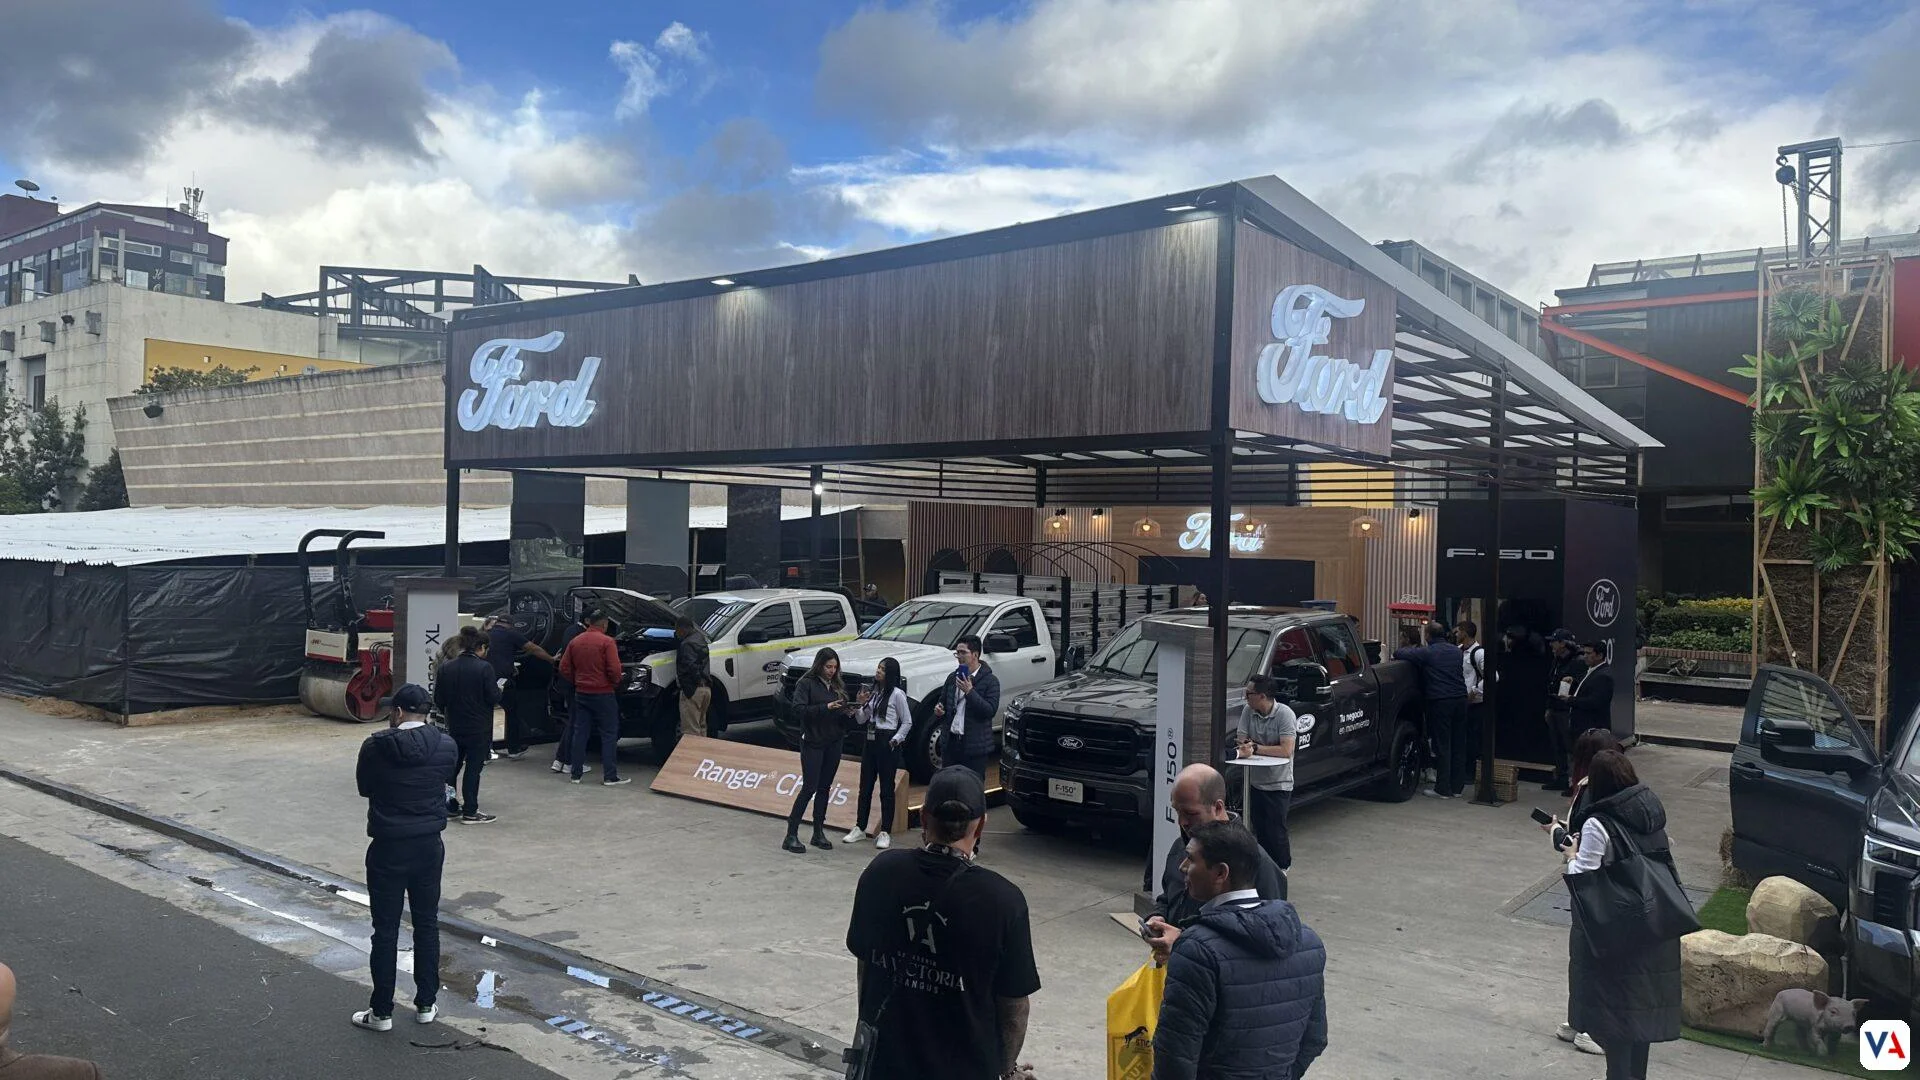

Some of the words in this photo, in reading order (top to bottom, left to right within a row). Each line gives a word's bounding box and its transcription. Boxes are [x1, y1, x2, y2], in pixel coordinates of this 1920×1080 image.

[1257, 284, 1393, 424] Ford
[457, 331, 602, 432] Ford
[1447, 548, 1555, 560] F-50
[1593, 585, 1615, 618] Ford
[425, 624, 440, 645] XL
[1339, 713, 1346, 723] Tu
[1346, 709, 1364, 721] negocio
[1299, 733, 1311, 745] PRO
[775, 773, 850, 806] Chis
